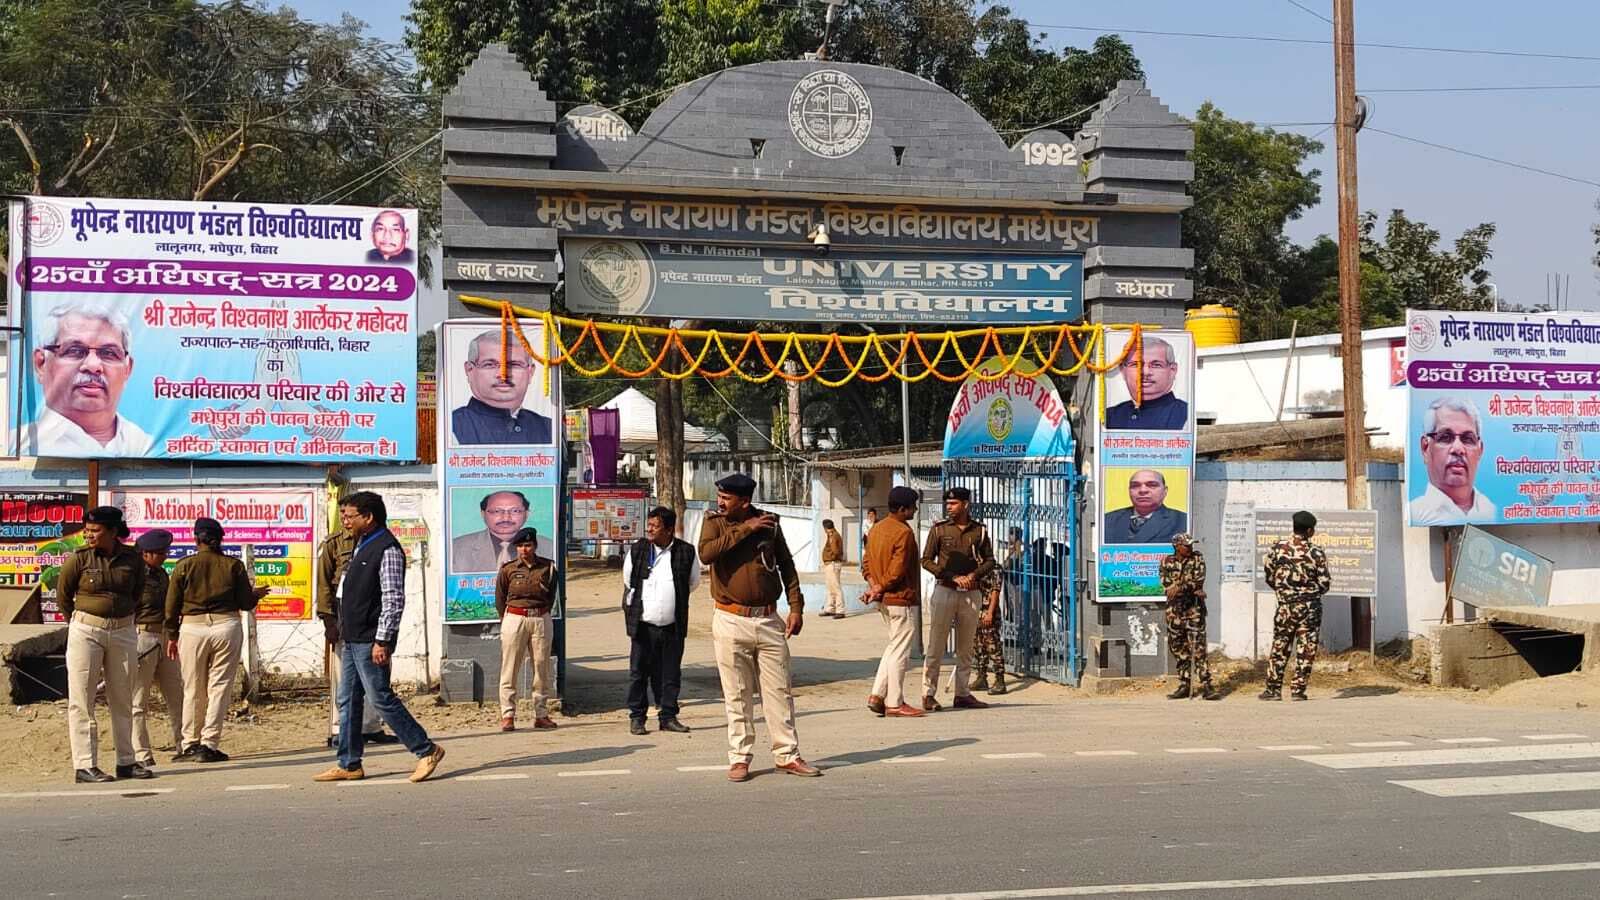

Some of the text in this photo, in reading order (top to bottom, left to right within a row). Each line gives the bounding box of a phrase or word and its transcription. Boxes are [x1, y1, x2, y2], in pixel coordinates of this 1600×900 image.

[566, 113, 628, 142] स्थापित
[1022, 142, 1078, 166] 1992
[71, 202, 120, 241] भूपेन्द्र
[124, 208, 195, 235] नारायण
[199, 205, 244, 236] मंडल
[249, 207, 363, 240] विश्वविद्यालय
[631, 200, 740, 231] नारायण
[155, 242, 278, 256] लालूनगर, मधेपुरा, बिहार
[660, 244, 761, 256] B. N. Mandal
[31, 260, 110, 284] 25वाँ
[329, 274, 398, 292] 2024
[458, 262, 496, 280] लालू
[692, 272, 732, 283] नारायण
[736, 273, 762, 284] मंडल
[763, 257, 1073, 280] UNIVERSITY
[786, 276, 814, 285] Laloo
[911, 280, 939, 288] Bihar,
[942, 280, 994, 288] PIN-852113
[764, 289, 1073, 313] विश्वविद्यालय
[144, 300, 408, 332] श्री राजेन्द्र विश्वनाथ आर्लेकर महोदय
[1440, 315, 1470, 347] भूपेन्द्र
[1473, 321, 1514, 342] नारायण
[1517, 317, 1544, 342] मंडल
[338, 337, 370, 352] बिहार
[267, 359, 284, 372] का
[1417, 363, 1466, 383] 25वाँ
[154, 377, 260, 400] विश्वविद्यालय
[267, 379, 321, 401] परिवार
[326, 380, 349, 402] की
[355, 382, 385, 403] ओर
[390, 382, 406, 403] से
[1489, 394, 1501, 416] श्री
[1505, 395, 1532, 417] राजेन्द्र
[1536, 394, 1574, 417] विश्वनाथ
[191, 408, 375, 430] मधेपुरा की पावन धरती पर
[167, 435, 213, 454] हार्दिक
[220, 440, 269, 454] स्वागत
[274, 437, 297, 454] एवं
[300, 438, 374, 455] अभिनन्दन
[1563, 440, 1573, 450] का
[1497, 456, 1595, 475] विश्वविद्यालय परिवार
[1520, 482, 1548, 497] मधेपुरा
[1551, 481, 1563, 494] की
[1567, 483, 1588, 494] पावन
[2, 501, 84, 523] Moon
[143, 497, 305, 522] National Seminar on
[1504, 504, 1533, 519] हार्दिक
[1535, 506, 1566, 518] स्वागत
[1568, 503, 1580, 517] एवं
[254, 548, 282, 556] 2024
[268, 563, 282, 575] By
[1499, 551, 1538, 586] SBI
